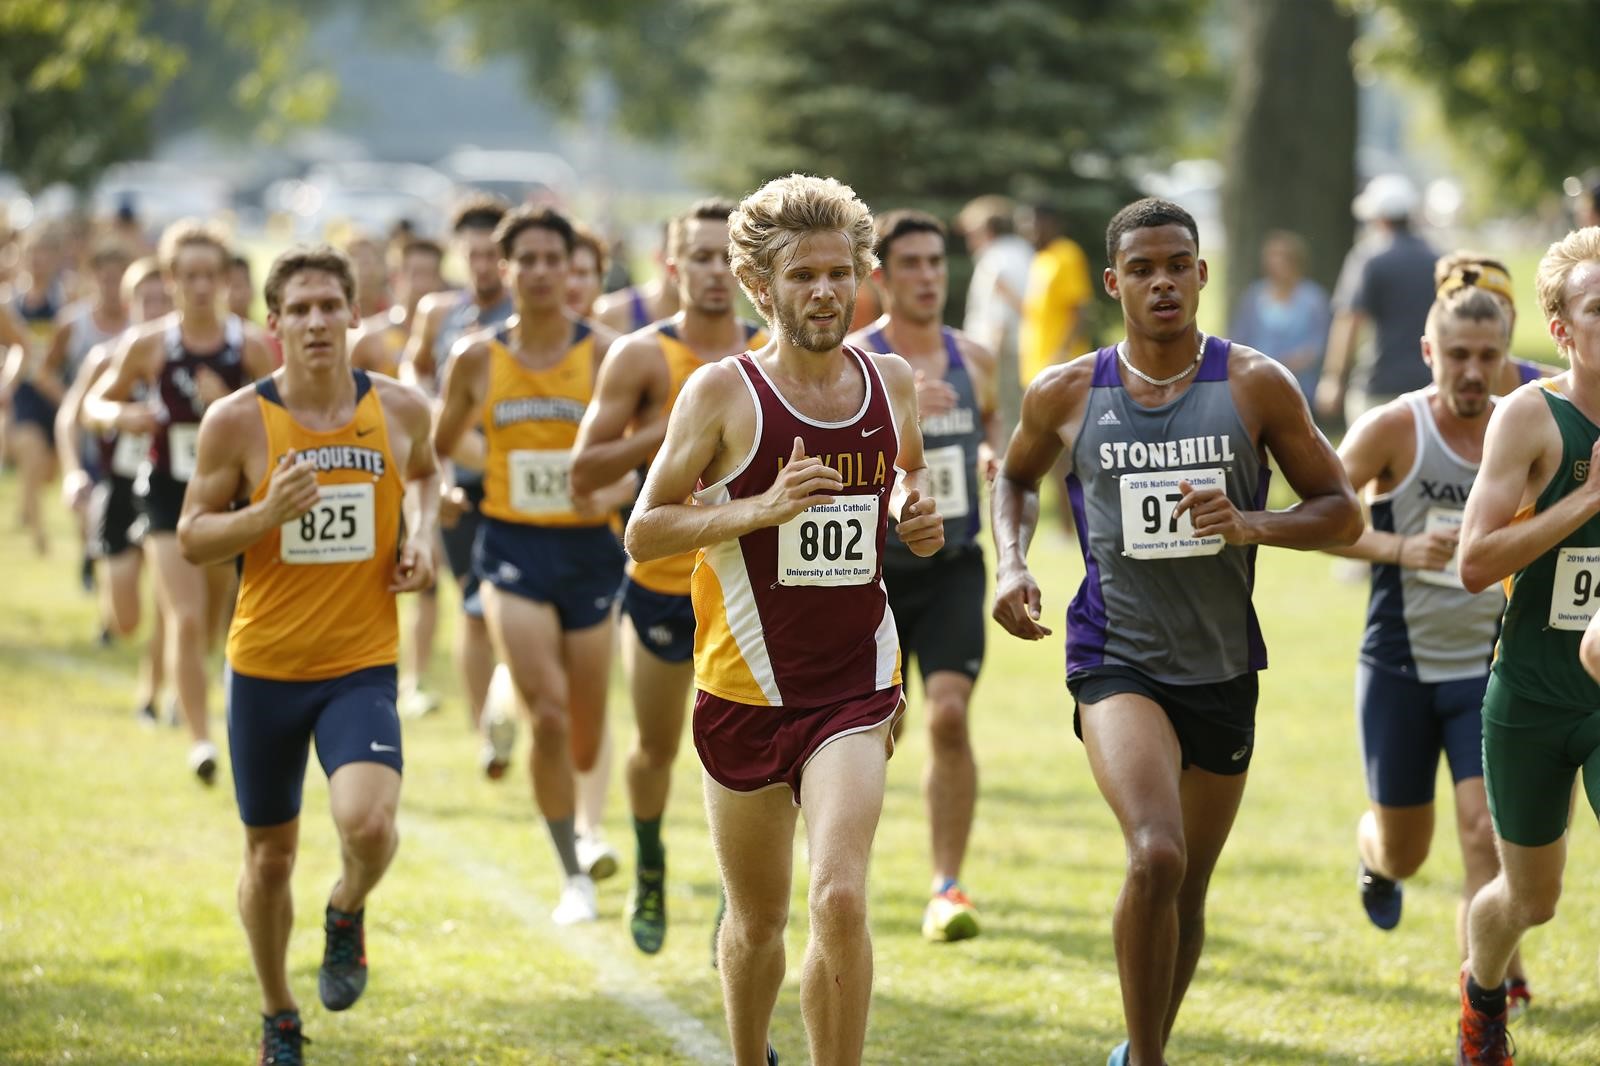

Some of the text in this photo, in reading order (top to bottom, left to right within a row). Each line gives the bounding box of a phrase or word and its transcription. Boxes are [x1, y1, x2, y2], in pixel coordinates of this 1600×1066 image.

[1100, 435, 1235, 470] STONEHILL
[1130, 481, 1148, 489] 2016
[1150, 479, 1180, 488] Nationa
[811, 504, 841, 513] National
[843, 503, 871, 512] Catholic
[301, 505, 356, 542] 825
[800, 518, 863, 561] 802
[1132, 542, 1168, 550] University
[1170, 540, 1177, 548] of
[1180, 539, 1199, 547] Notre
[1567, 554, 1584, 562] 2016
[787, 568, 823, 578] University
[834, 567, 851, 576] Notre
[853, 567, 870, 575] Dame
